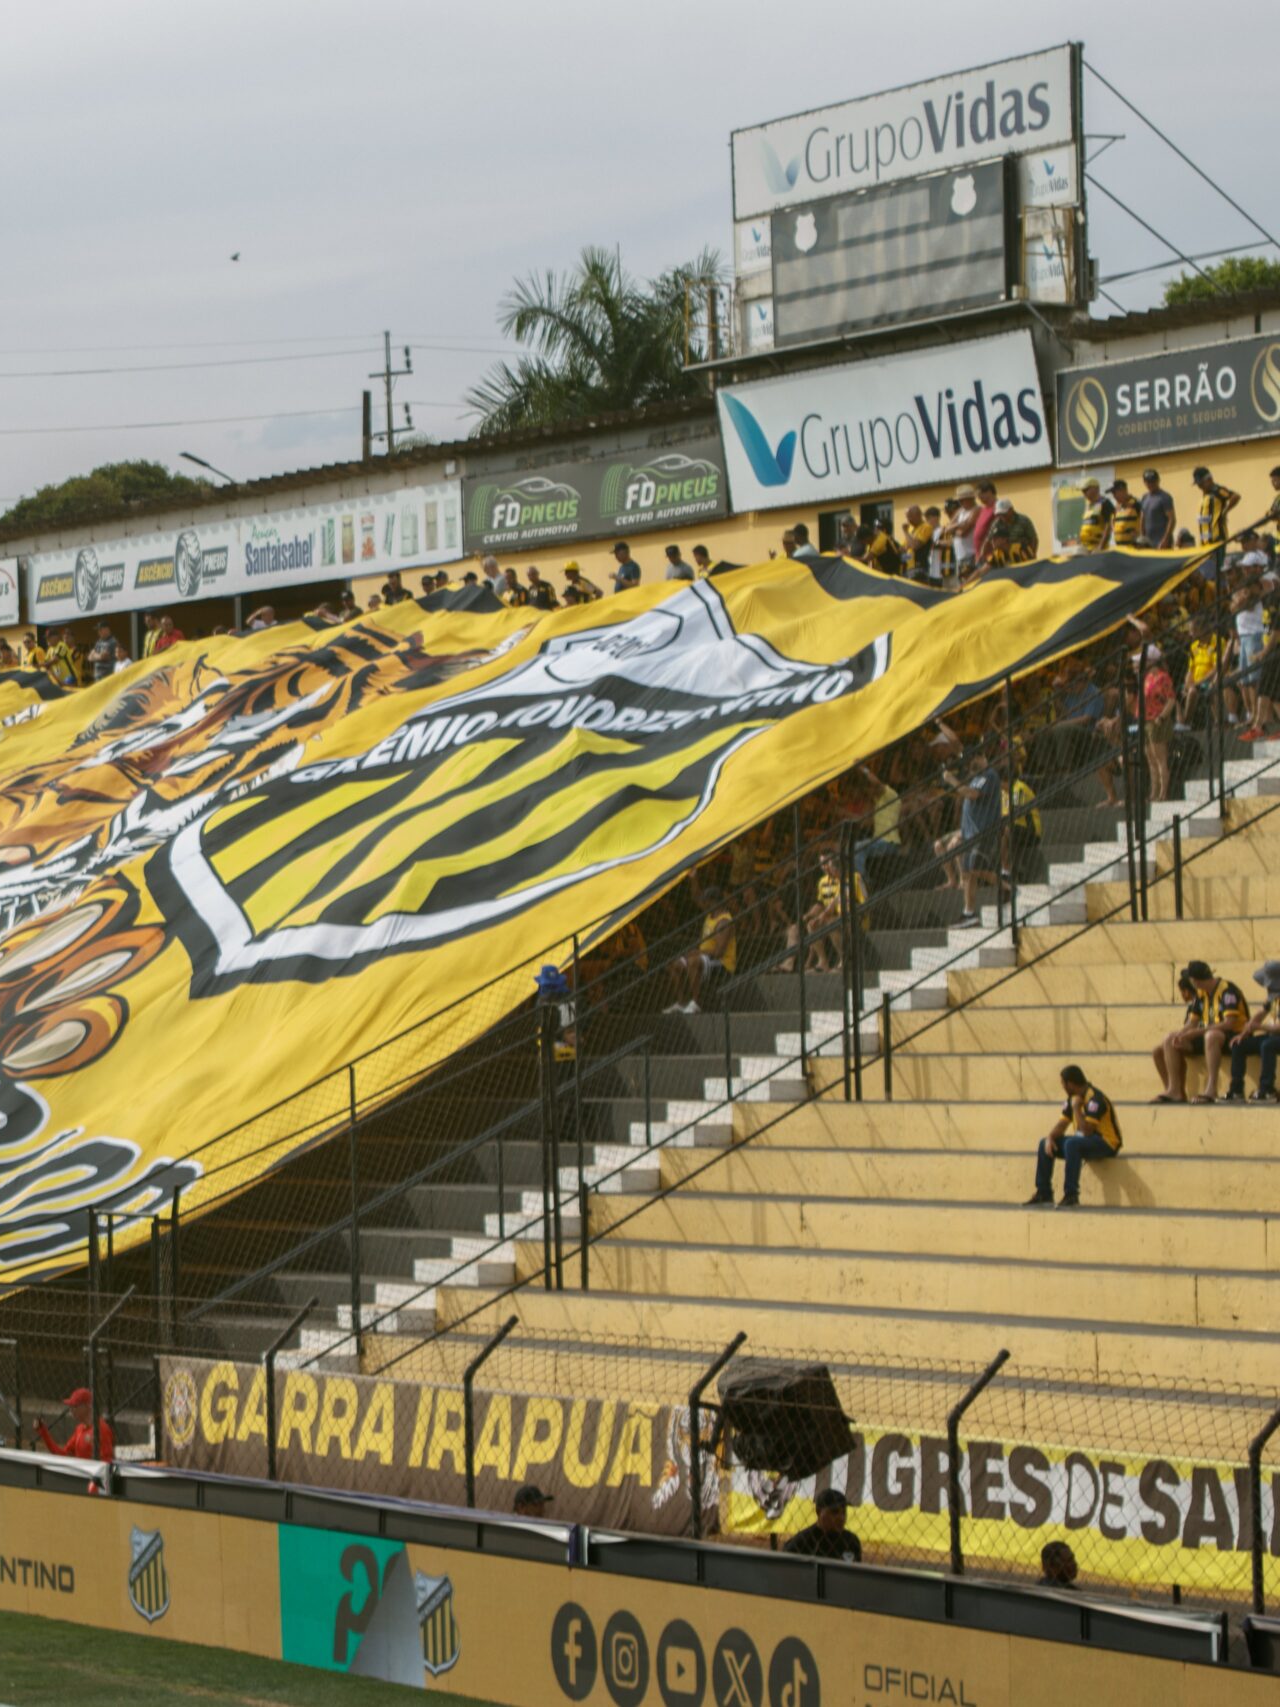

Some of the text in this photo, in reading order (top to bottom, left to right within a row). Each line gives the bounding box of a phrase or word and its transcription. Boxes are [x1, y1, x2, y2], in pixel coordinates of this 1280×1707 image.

[1115, 362, 1237, 417] SERRÃO
[1117, 405, 1238, 437] CORRETORA DE SEGUROS
[615, 499, 717, 526] CENTRO AUTOMOTIVO
[483, 523, 578, 544] CENTRO AUTOMOTIVO
[202, 550, 228, 574] PNEUS
[200, 1361, 395, 1466] GARRA
[1138, 1459, 1280, 1558] SAL
[863, 1663, 977, 1707] OFICIAL
